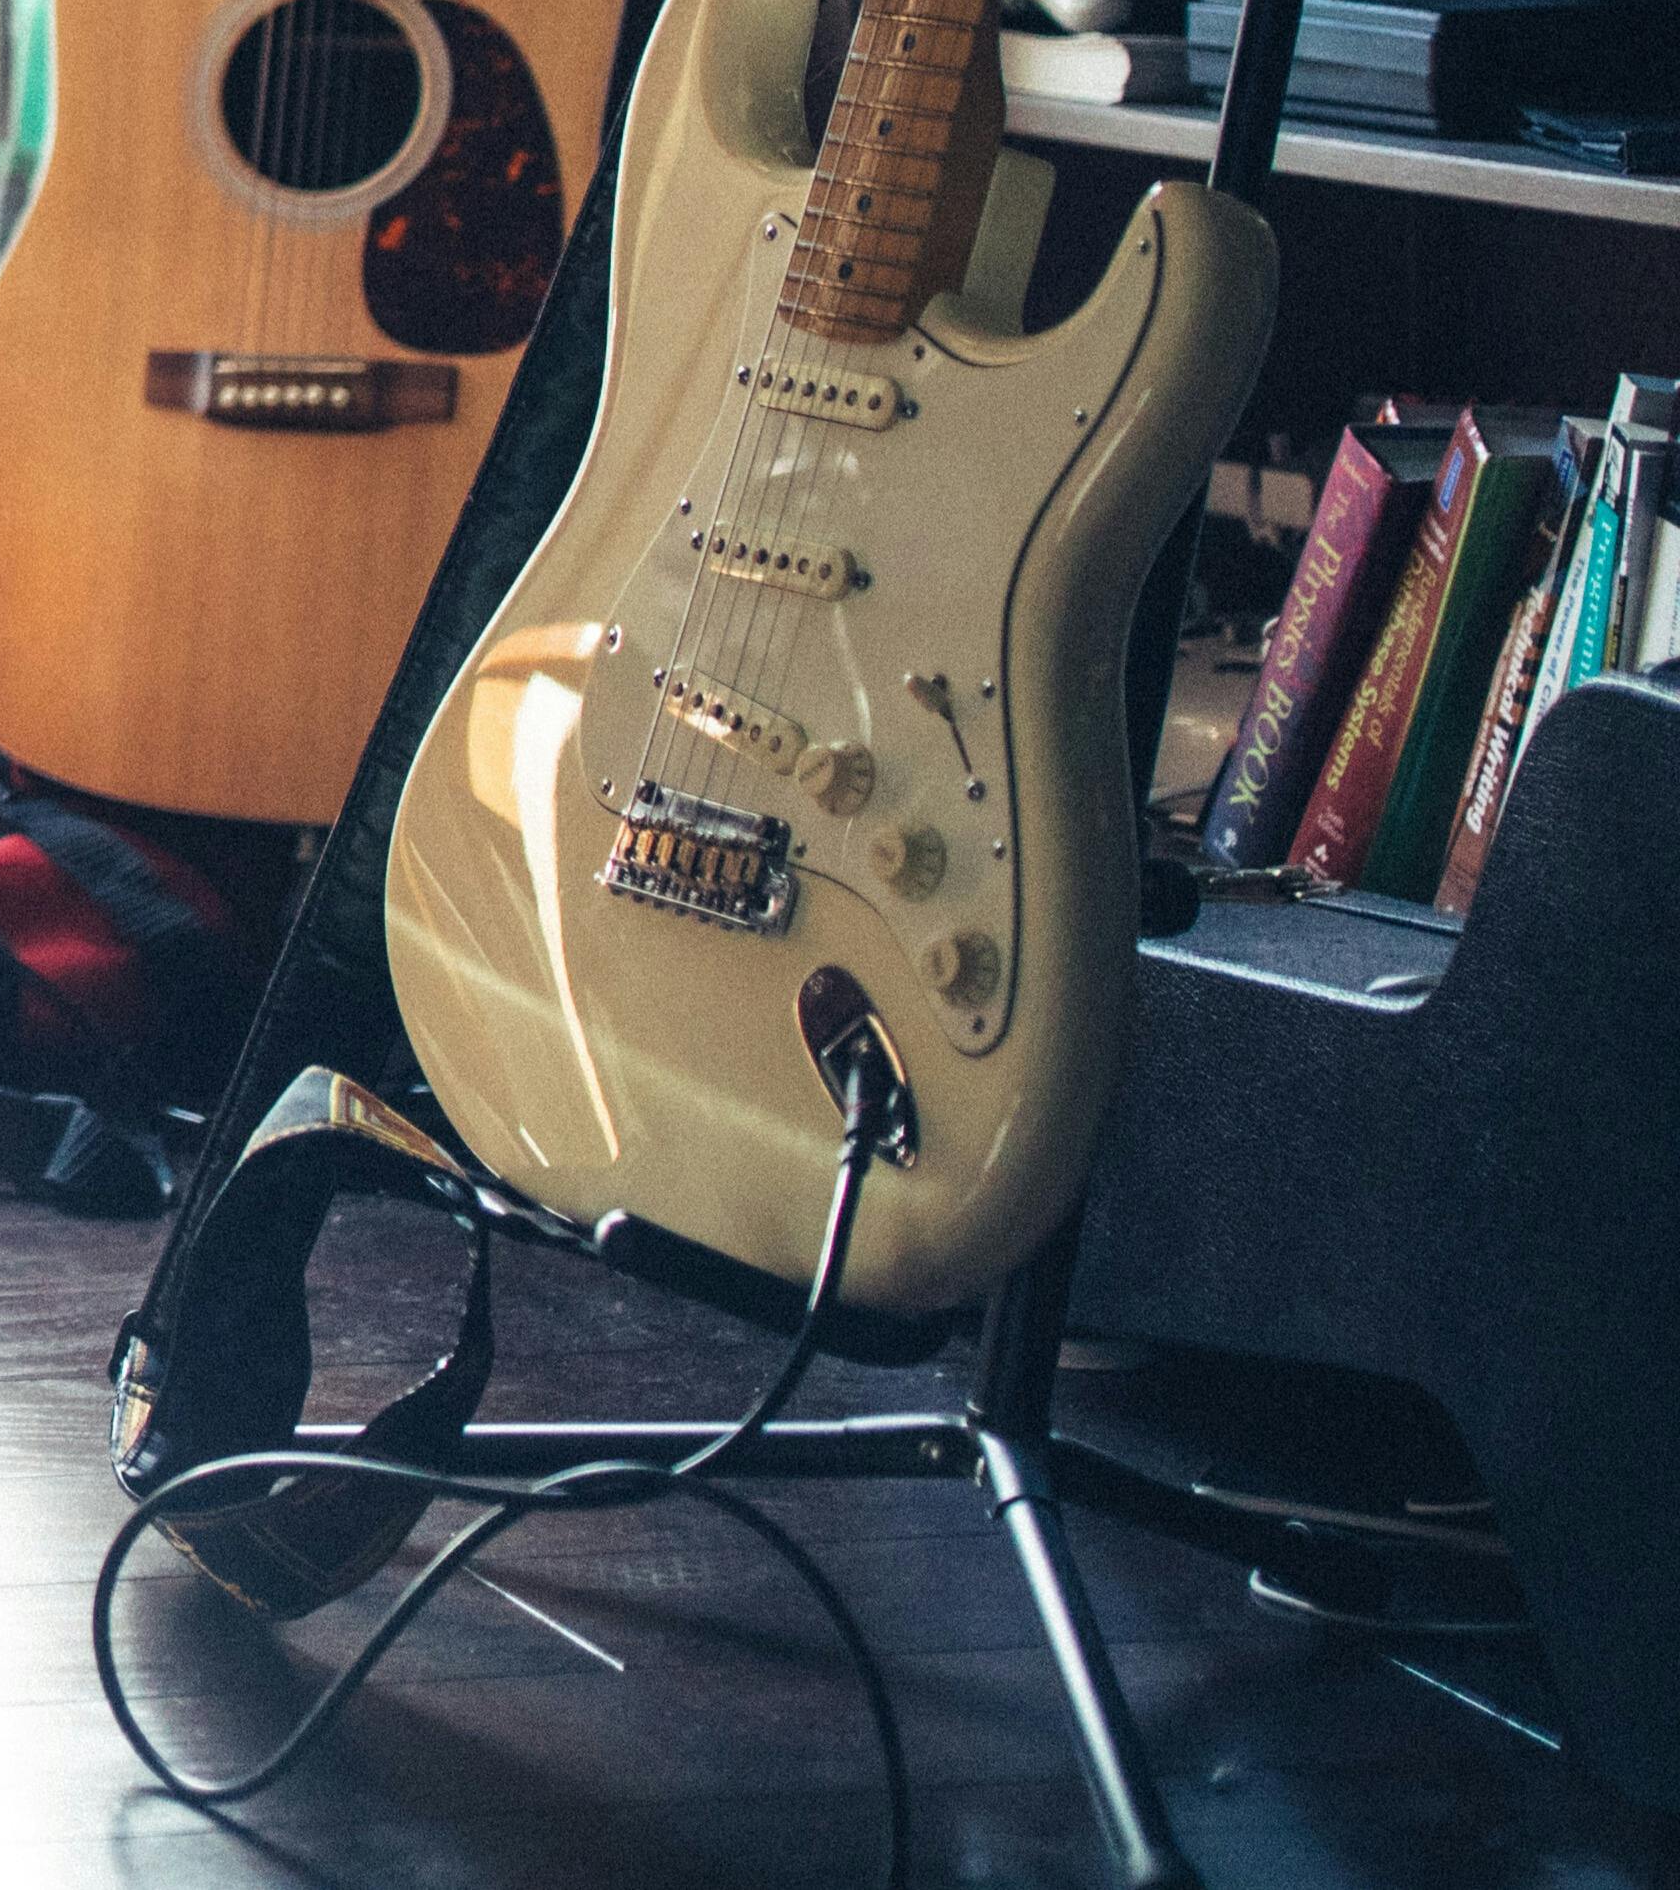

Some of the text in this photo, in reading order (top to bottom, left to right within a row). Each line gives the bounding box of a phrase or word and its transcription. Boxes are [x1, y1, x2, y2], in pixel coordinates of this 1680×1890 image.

[1228, 491, 1351, 813] The Physics BOOK
[1385, 563, 1439, 714] Fundamentals
[1499, 584, 1547, 722] Technical
[1326, 682, 1379, 791] Systems
[1466, 721, 1510, 834] Writing
